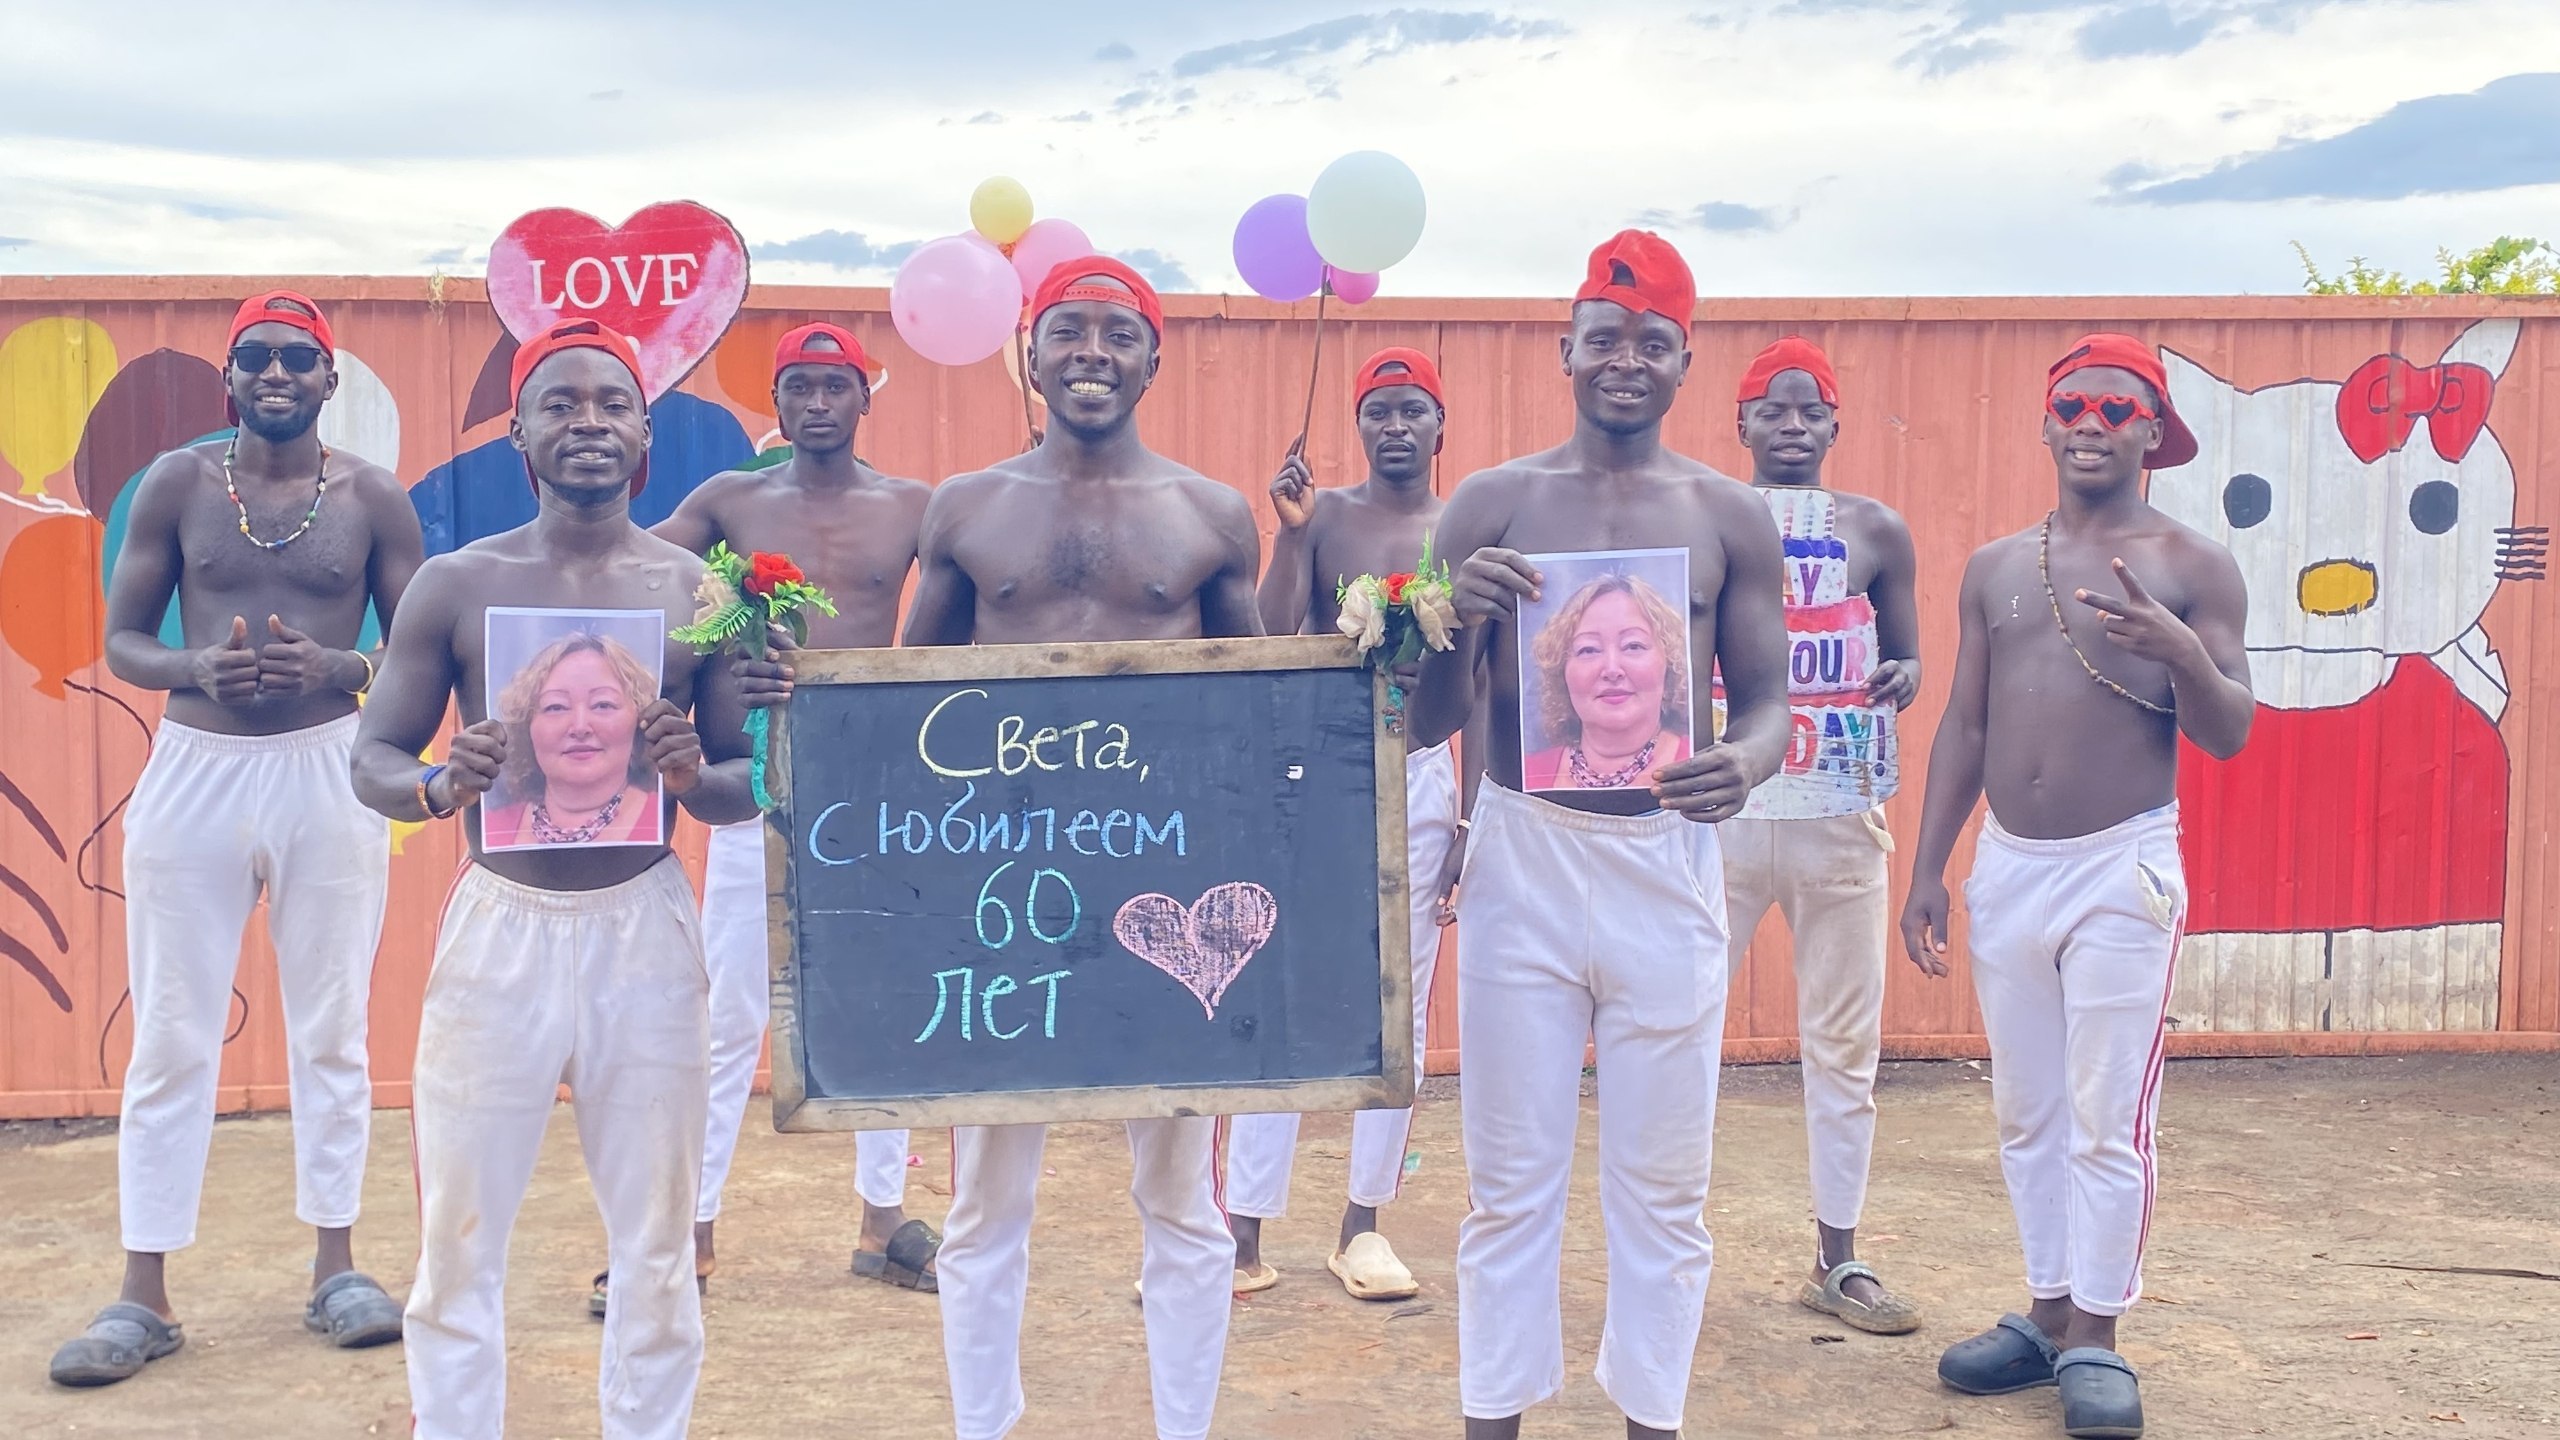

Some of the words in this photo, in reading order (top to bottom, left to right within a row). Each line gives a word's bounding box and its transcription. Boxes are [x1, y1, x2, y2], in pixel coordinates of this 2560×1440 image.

[528, 253, 699, 310] LOVE
[1788, 637, 1867, 685] OUR
[918, 688, 1150, 783] Света,
[878, 781, 1187, 858] юбилеем
[975, 861, 1081, 950] 60
